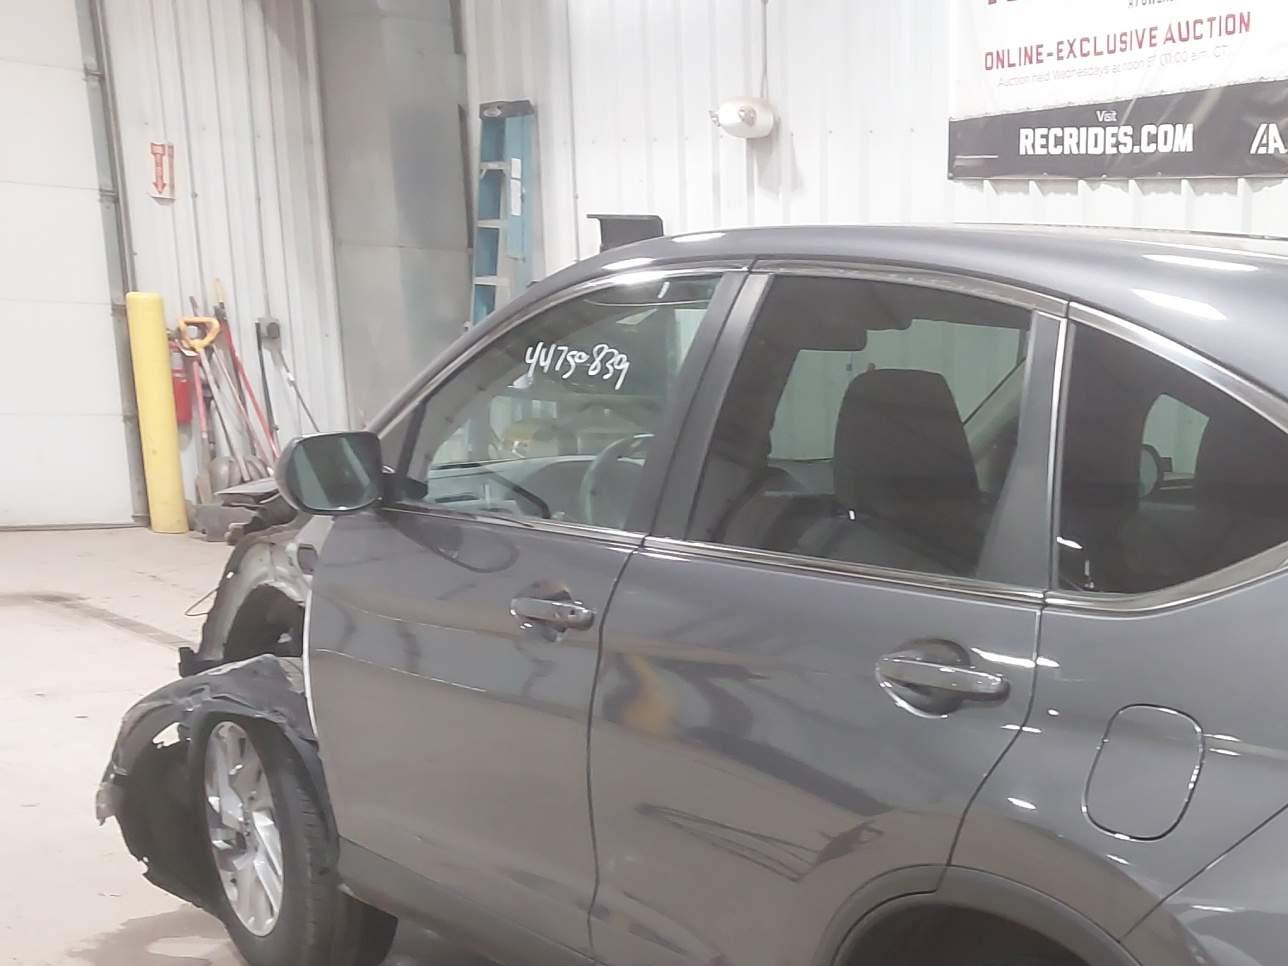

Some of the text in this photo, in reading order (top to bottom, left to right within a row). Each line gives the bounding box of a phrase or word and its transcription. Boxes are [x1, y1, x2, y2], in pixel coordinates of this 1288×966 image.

[984, 12, 1251, 71] ONLINE-EXCLUSIVE AUCTION
[1018, 123, 1194, 155] RECRIDES.COM
